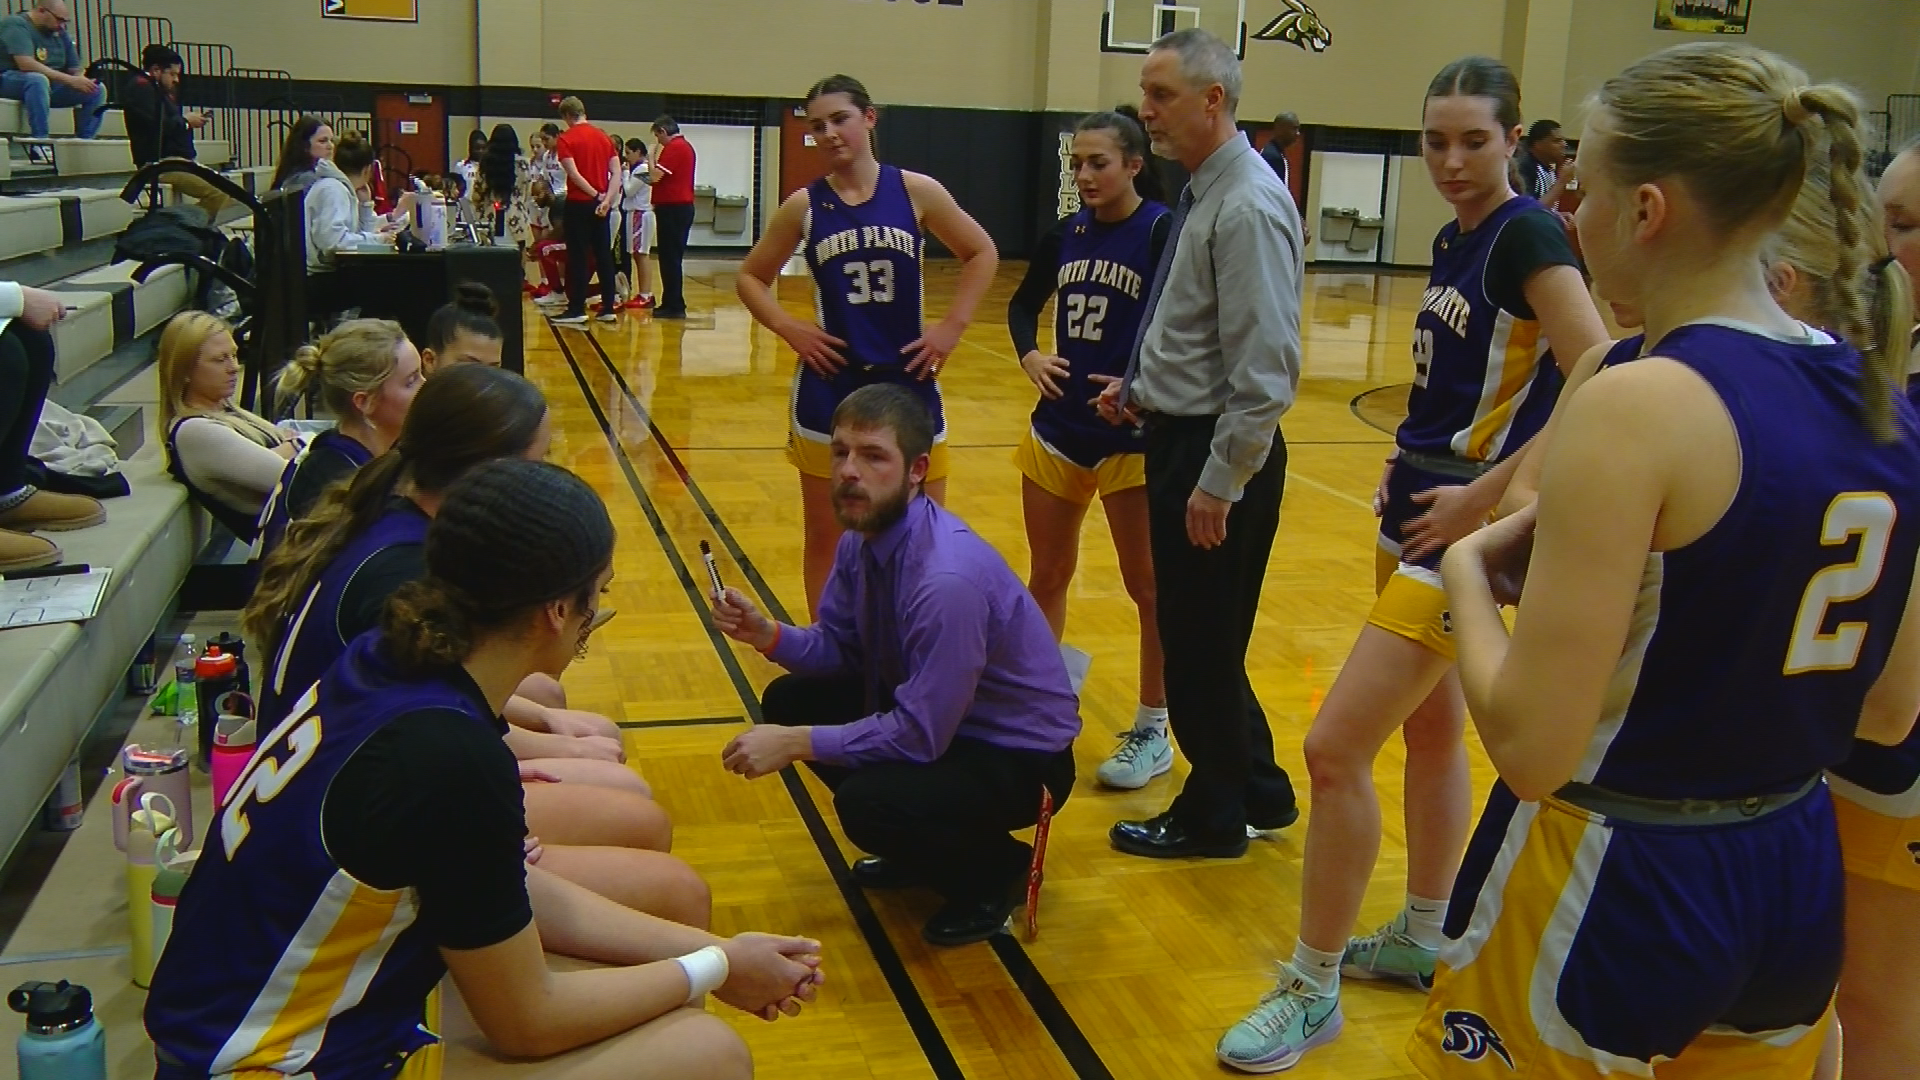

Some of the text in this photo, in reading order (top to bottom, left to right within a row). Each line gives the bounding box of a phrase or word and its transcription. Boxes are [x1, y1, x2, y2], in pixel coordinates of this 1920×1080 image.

[815, 225, 916, 266] NORTH PLATTE
[843, 259, 895, 304] 33
[1089, 259, 1143, 301] PLATTE
[1066, 293, 1109, 341] 22
[1782, 491, 1898, 677] 2
[219, 678, 323, 864] 12
